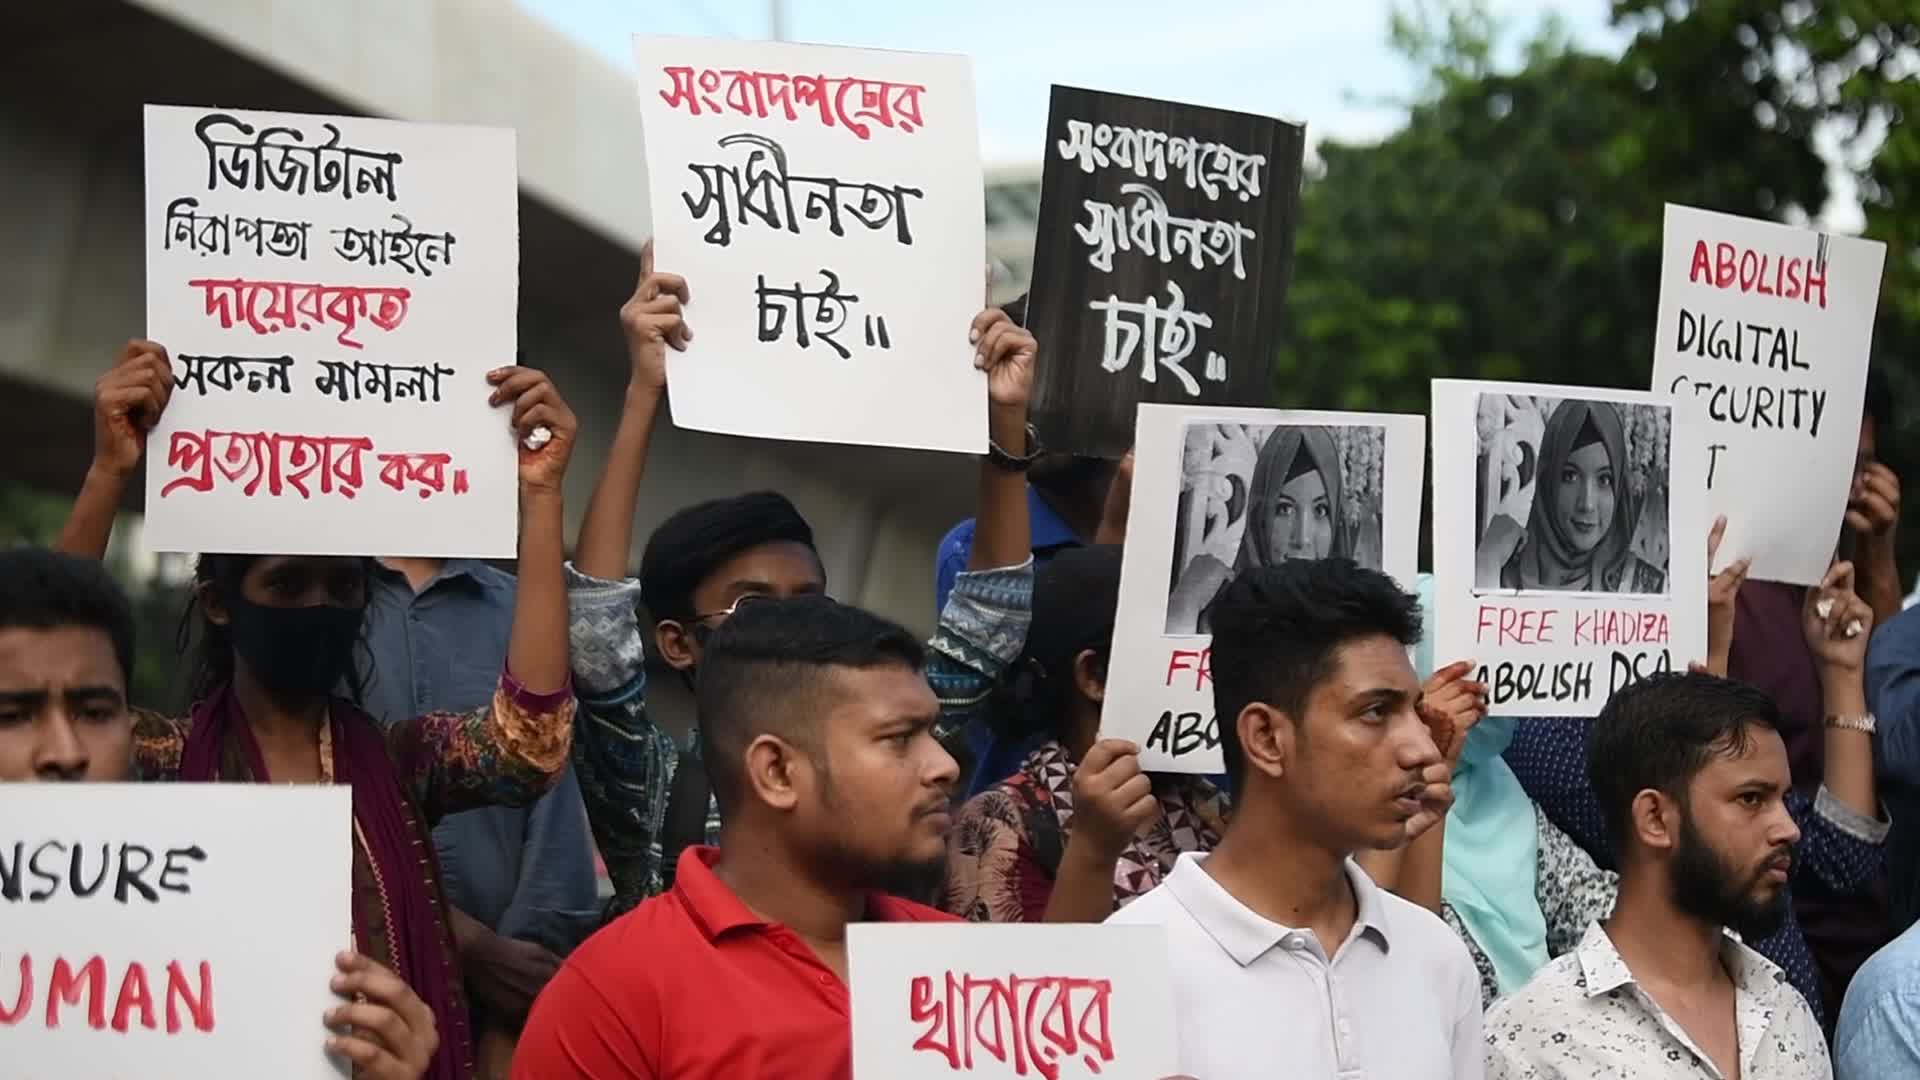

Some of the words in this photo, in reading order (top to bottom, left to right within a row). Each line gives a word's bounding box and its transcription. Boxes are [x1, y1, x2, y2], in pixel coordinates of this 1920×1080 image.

[660, 66, 926, 140] সংবাদপত্রের
[195, 114, 403, 201] ডিজিটাল
[681, 133, 924, 247] স্বাধীনতা
[1058, 119, 1266, 202] সংবাদপত্রের
[164, 197, 312, 261] নিরাপত্তা
[330, 214, 456, 277] আইনে
[1074, 183, 1256, 280] স্বাধীনতা
[1689, 239, 1827, 310] ABOLISH
[189, 278, 411, 349] দায়েরকৃত
[1676, 308, 1810, 373] DIGITAL
[174, 353, 295, 396] সকল
[315, 360, 455, 402] মামলা
[1670, 375, 1826, 438] CURITY
[160, 429, 374, 500] প্রত্যাহার
[1476, 604, 1558, 647] FREE
[1574, 608, 1670, 647] KHADIZA
[1165, 647, 1213, 692] FR
[1476, 661, 1594, 707] ABOLISH
[0, 840, 207, 904] NSURE
[0, 951, 216, 1035] UMAN
[910, 969, 1114, 1080] খাবারের
